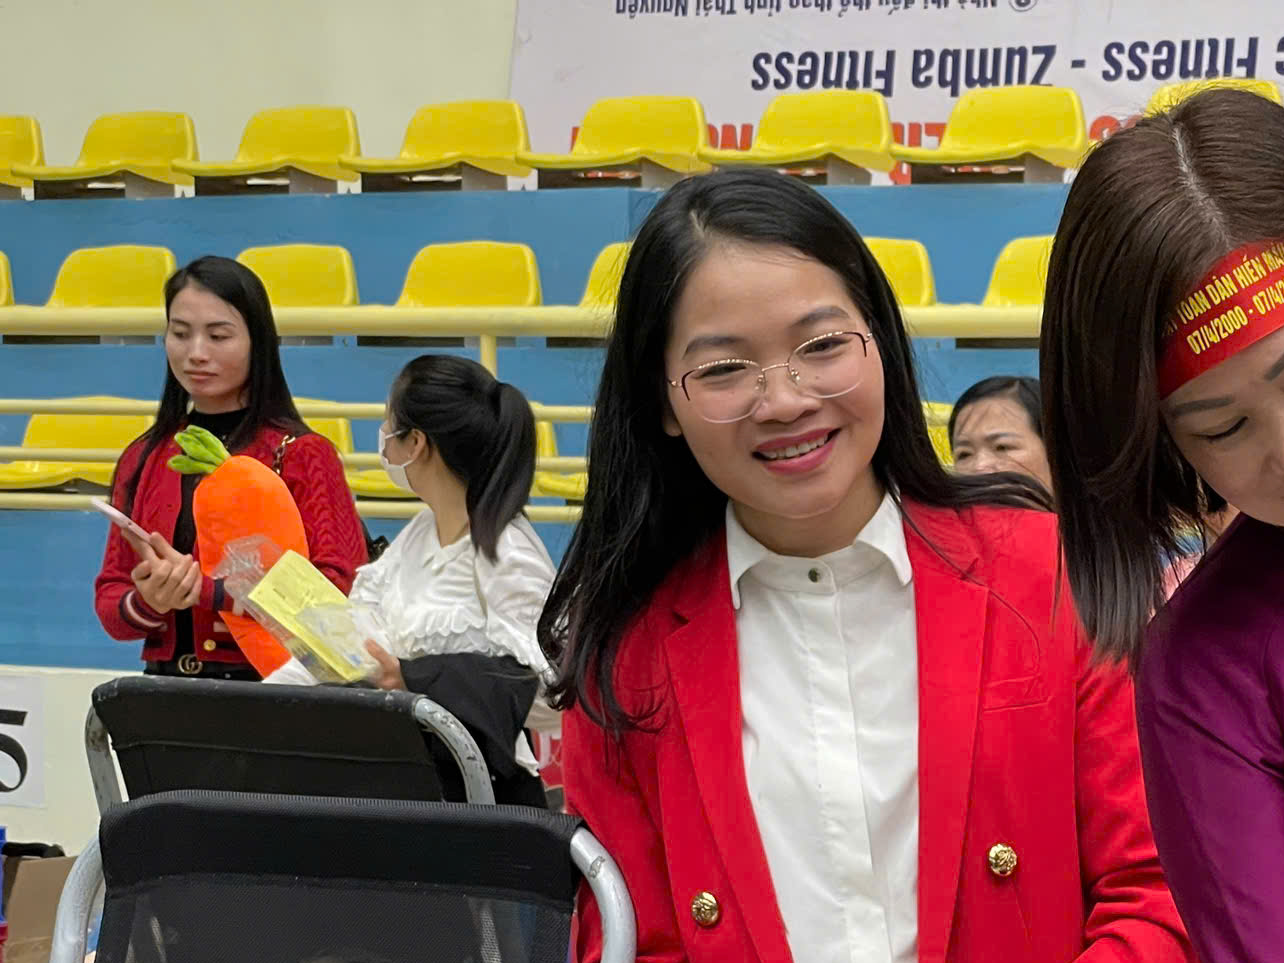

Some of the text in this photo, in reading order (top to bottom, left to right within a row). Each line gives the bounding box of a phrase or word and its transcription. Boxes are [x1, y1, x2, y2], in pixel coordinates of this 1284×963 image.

[751, 50, 897, 98] Fitness
[911, 45, 1057, 98] Zumba
[1101, 36, 1259, 82] Fitness
[1186, 305, 1249, 355] 07/4/2000
